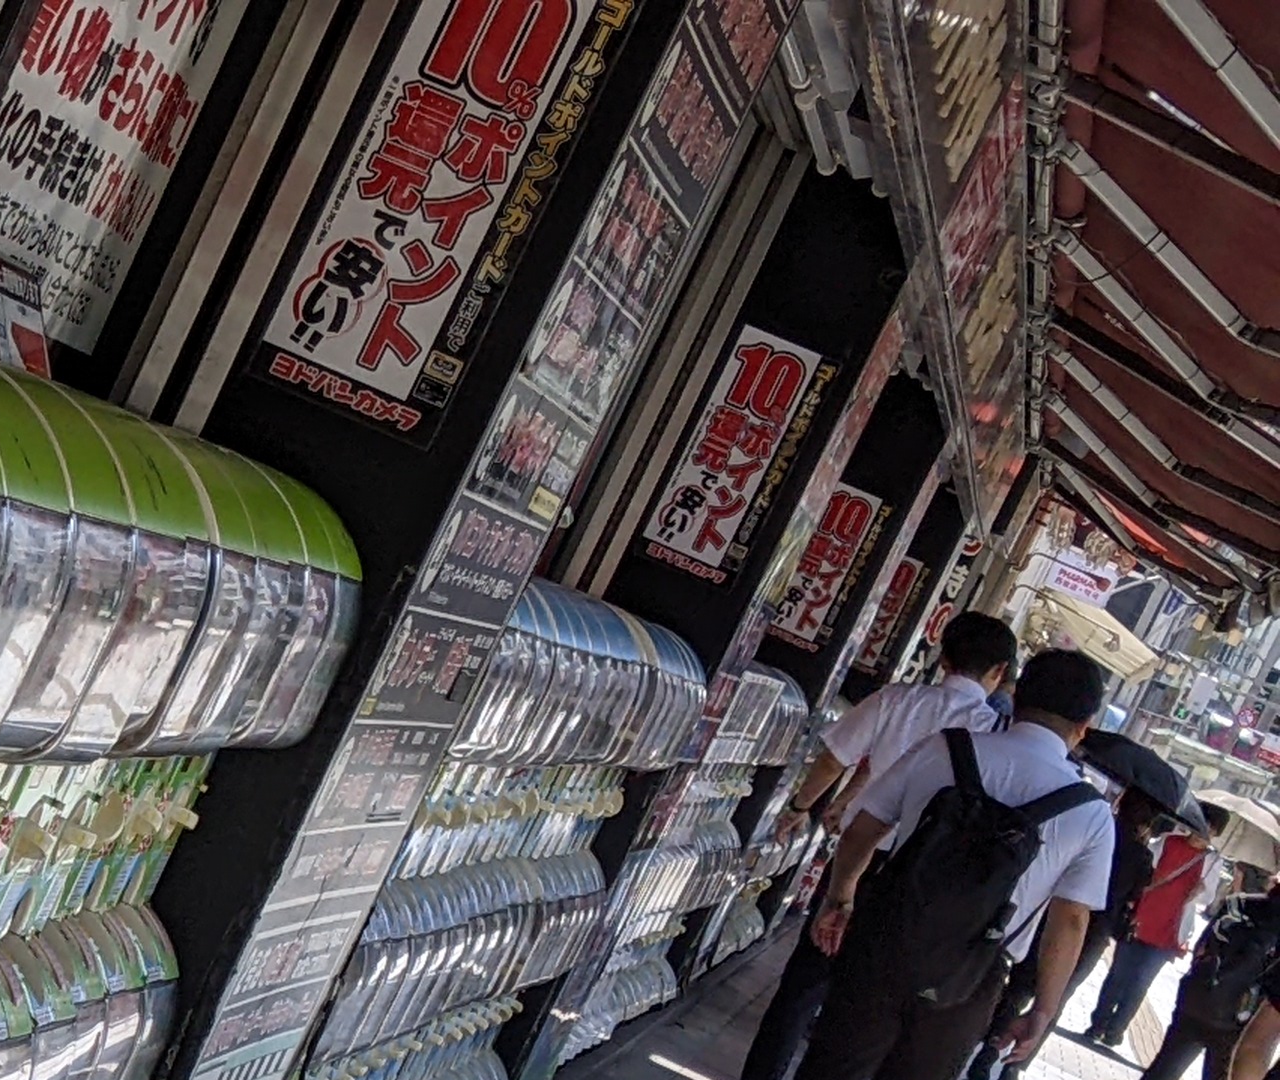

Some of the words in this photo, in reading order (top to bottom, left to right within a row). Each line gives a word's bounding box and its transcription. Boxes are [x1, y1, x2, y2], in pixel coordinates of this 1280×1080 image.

[357, 111, 531, 371] ポイント
[269, 352, 422, 432] ヨドバシカメラ
